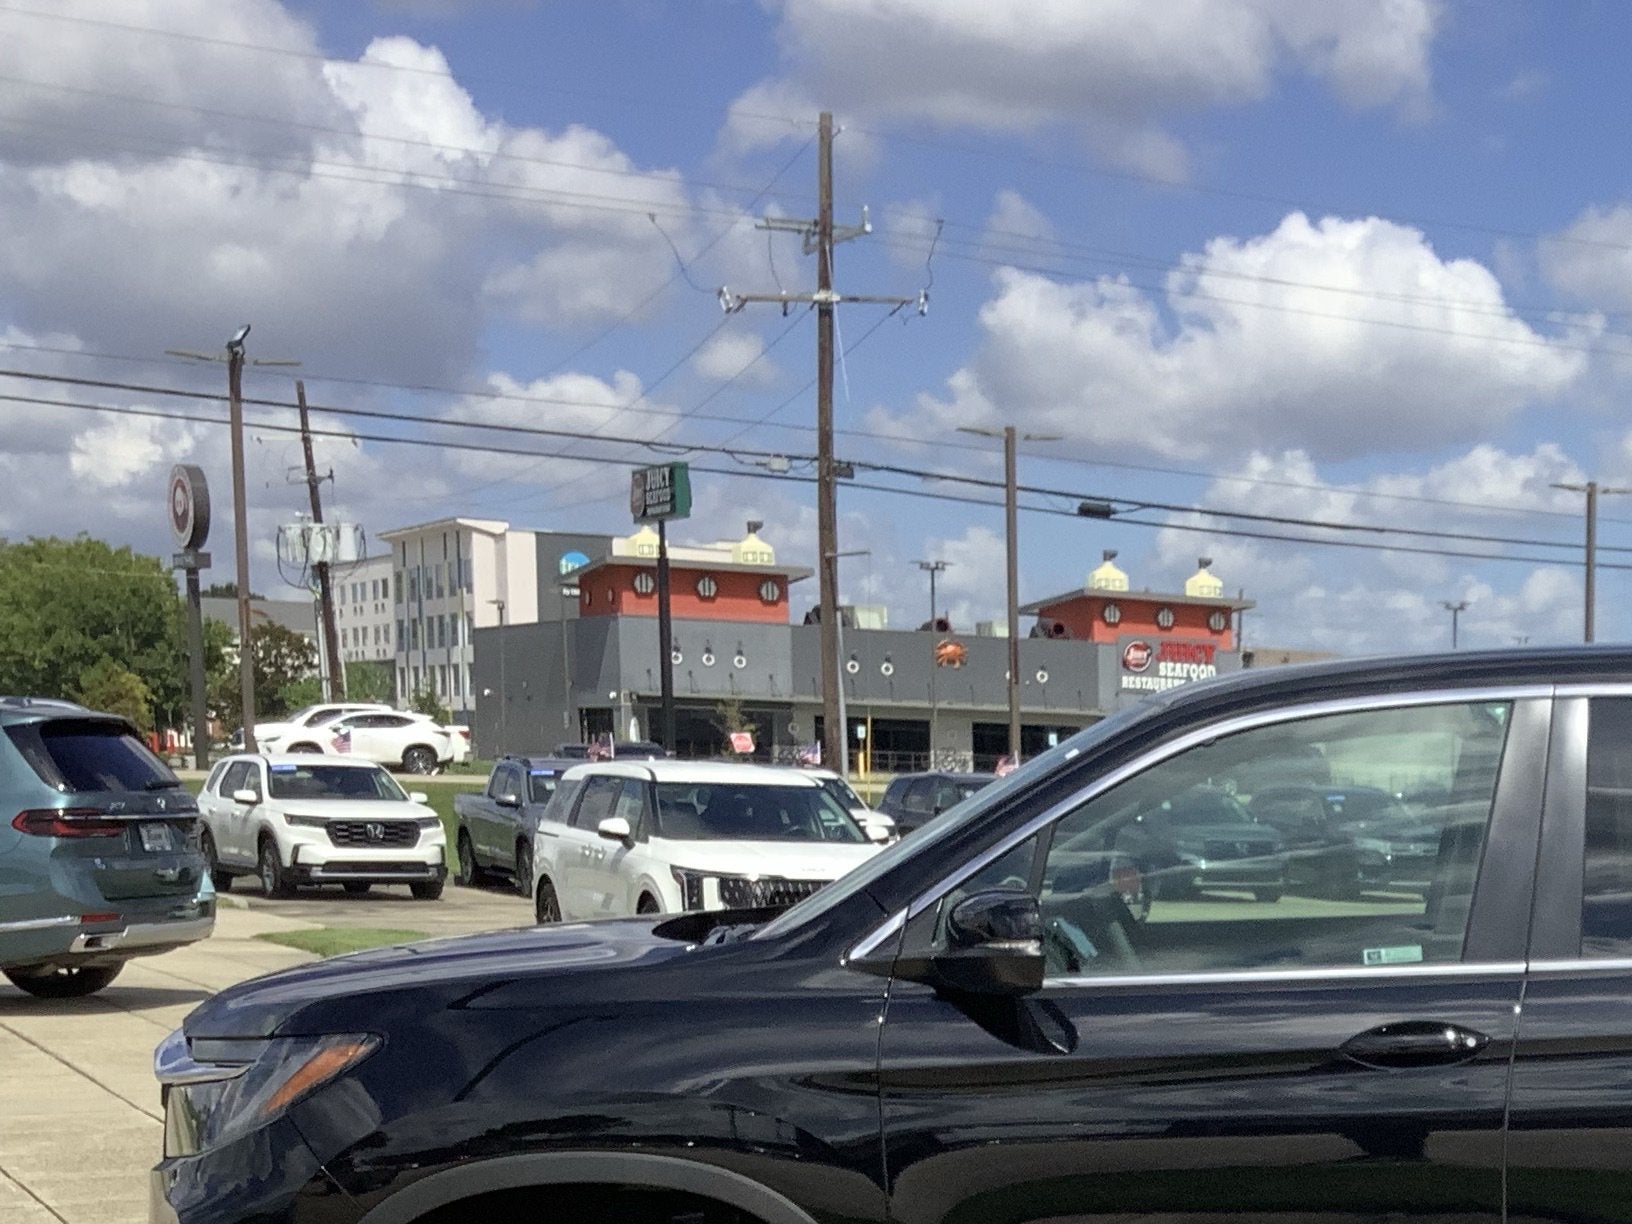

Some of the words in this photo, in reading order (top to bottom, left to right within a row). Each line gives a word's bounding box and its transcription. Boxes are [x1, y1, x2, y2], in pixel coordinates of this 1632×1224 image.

[646, 467, 670, 490] JUICY
[1157, 642, 1216, 664] JUICY
[1158, 662, 1217, 681] SEAFOOD
